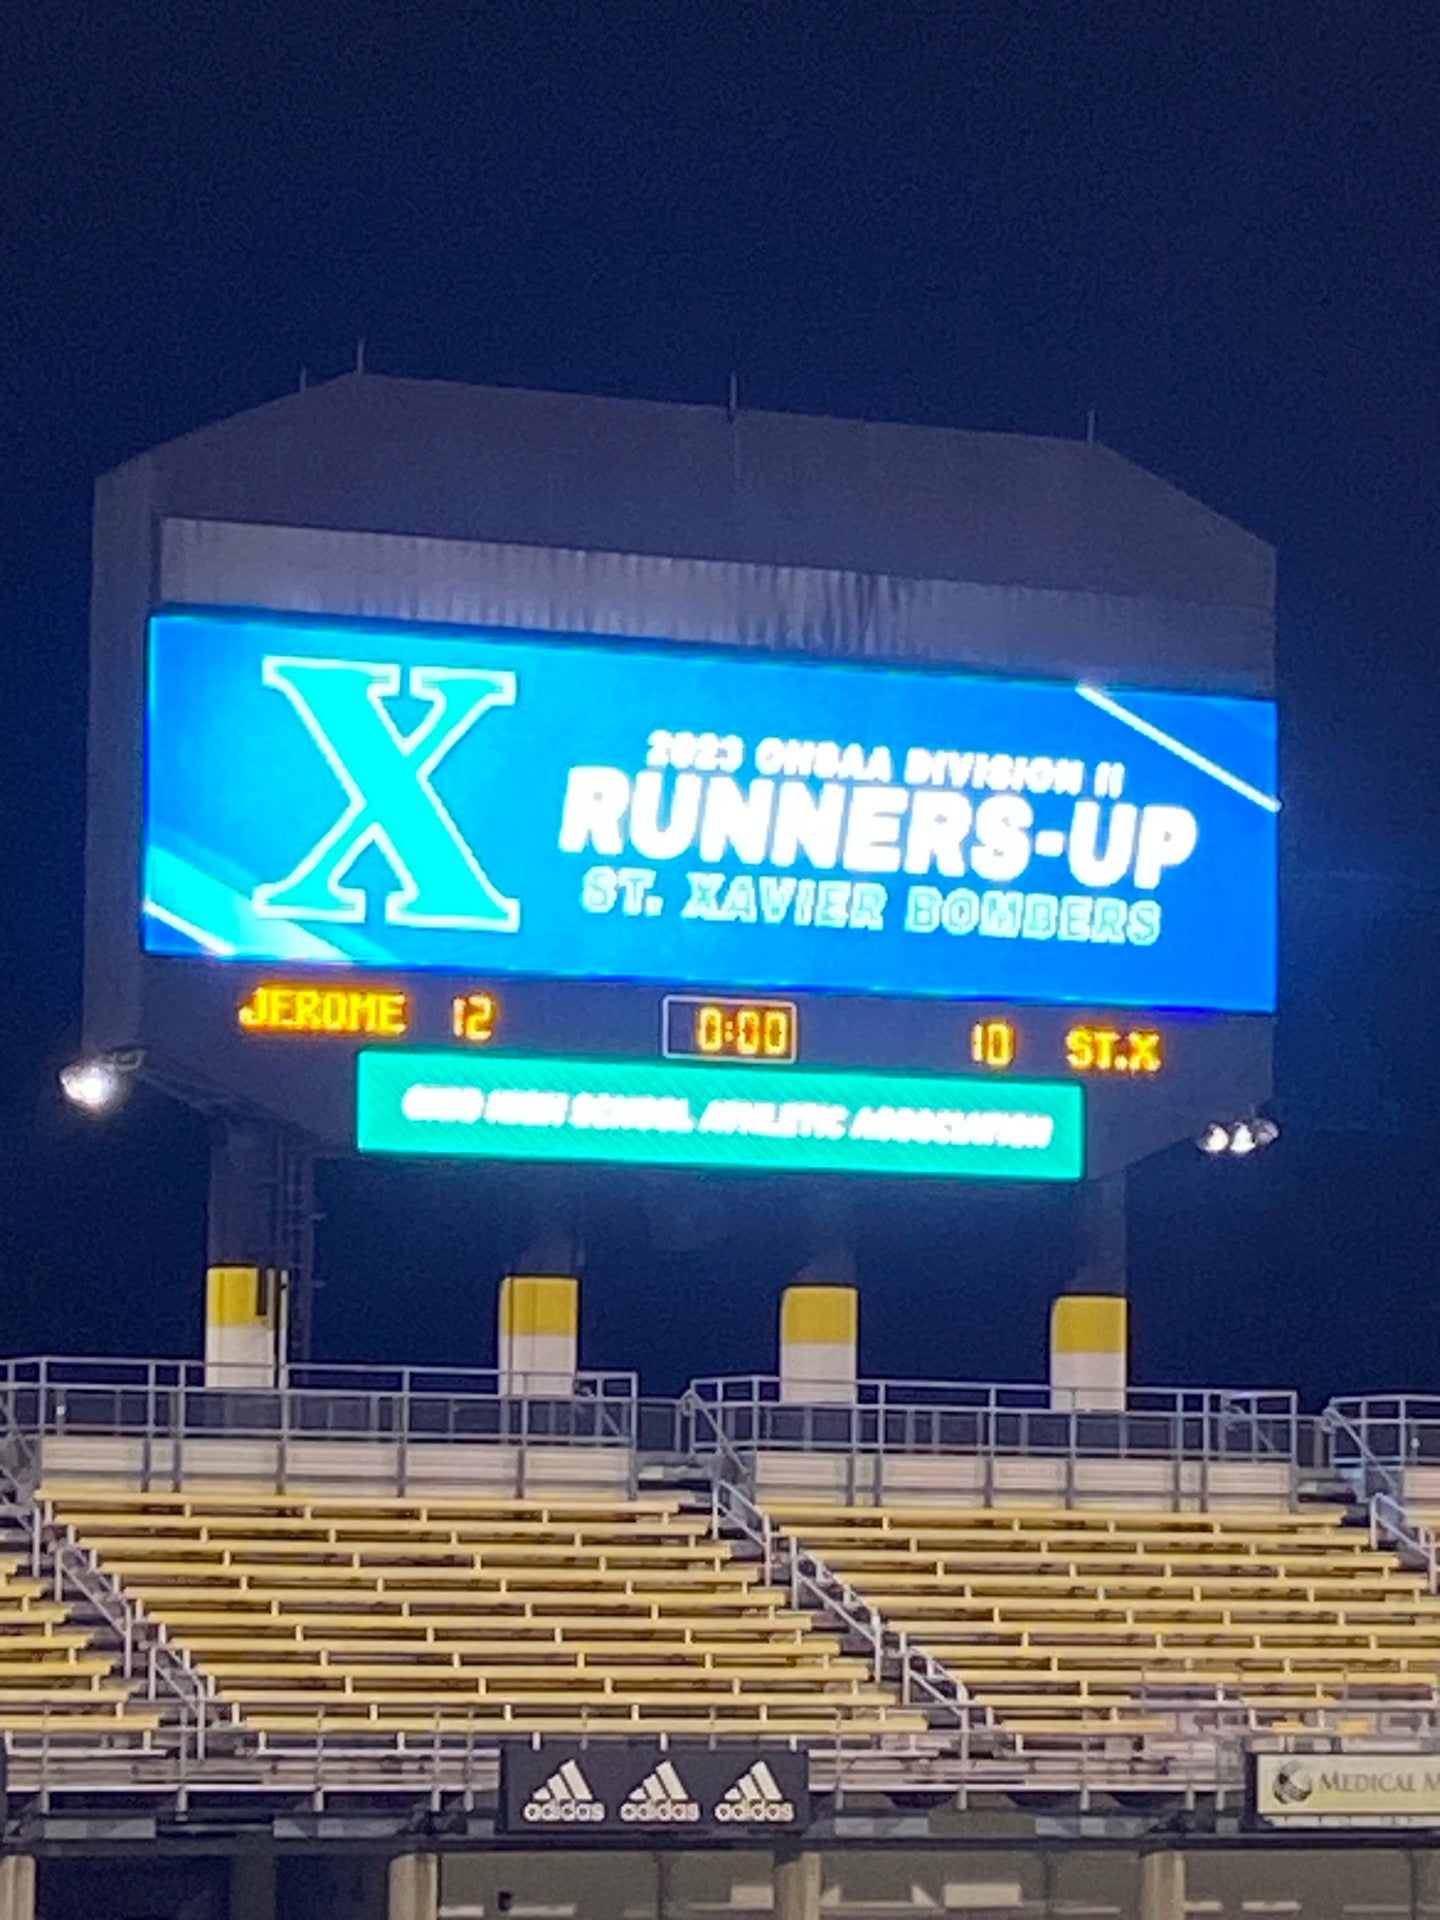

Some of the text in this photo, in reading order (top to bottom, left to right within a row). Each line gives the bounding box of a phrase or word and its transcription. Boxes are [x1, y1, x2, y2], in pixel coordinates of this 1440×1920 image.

[253, 655, 520, 932] X
[904, 747, 1085, 796] DIVISION
[558, 766, 1198, 890] RUNNERS-UP
[580, 865, 1162, 947] ST. XAVIER BOMBERS
[239, 986, 407, 1035] JEROME
[452, 994, 494, 1041] 12
[697, 1006, 789, 1056] 0:00
[970, 1020, 1016, 1067] 10
[1065, 1026, 1162, 1074] ST.X
[523, 1801, 605, 1822] adidas
[620, 1801, 700, 1822] adidas
[715, 1801, 794, 1822] adidas
